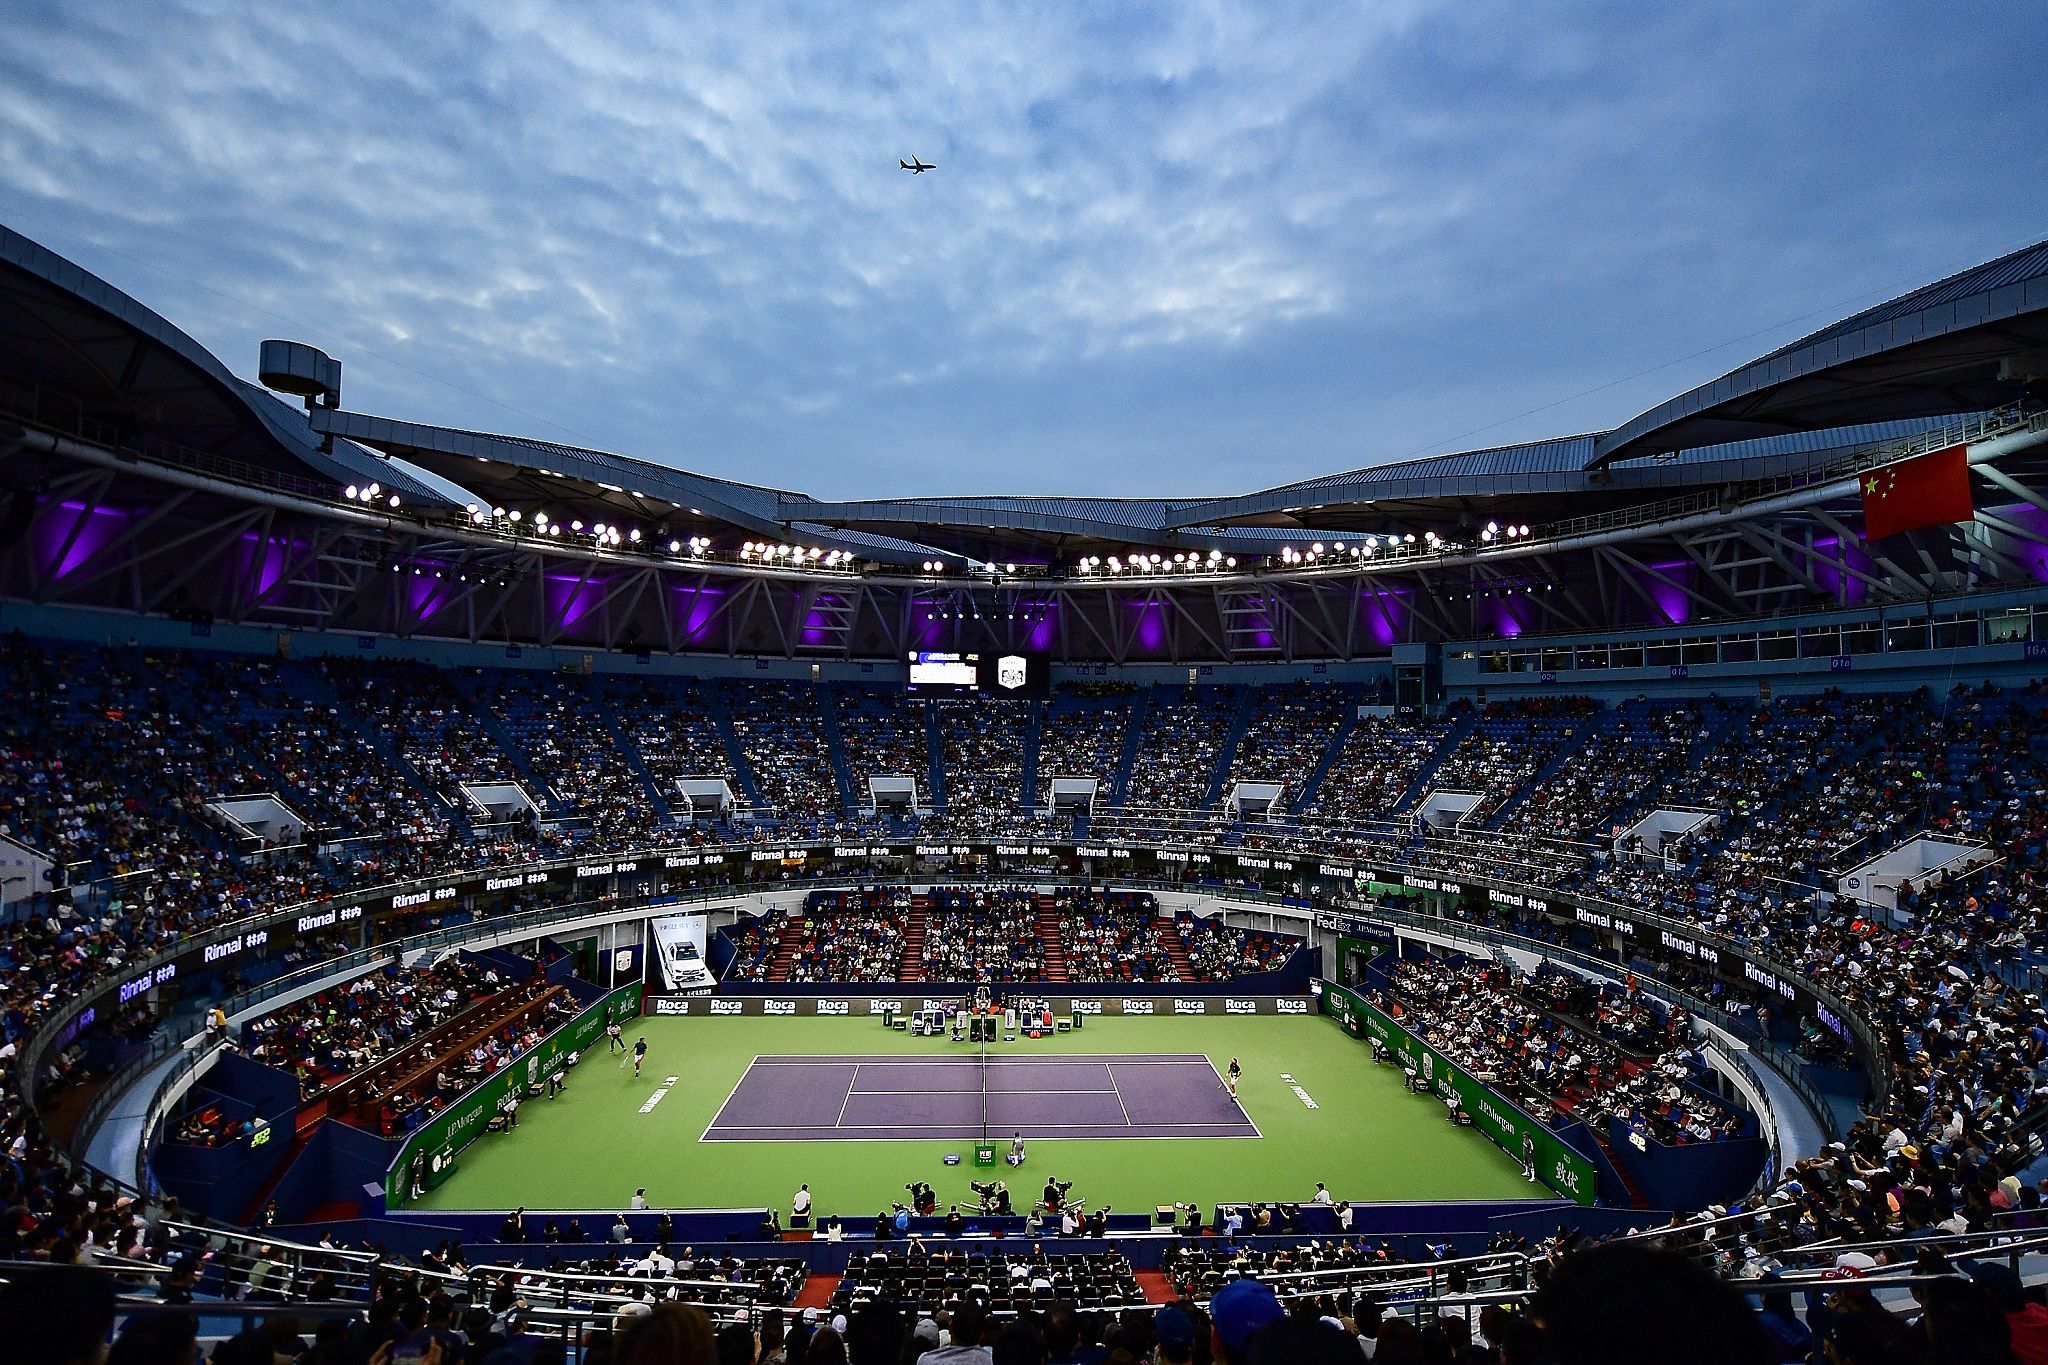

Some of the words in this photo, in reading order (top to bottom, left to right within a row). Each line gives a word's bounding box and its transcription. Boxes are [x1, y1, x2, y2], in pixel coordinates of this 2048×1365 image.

[2026, 644, 2047, 656] 16A
[1832, 659, 1850, 668] 01B
[1671, 668, 1686, 676] 01A
[752, 850, 785, 862] Rinnai
[835, 845, 866, 856] Rinnai
[916, 846, 947, 854] Rinnai
[997, 846, 1027, 854] Rinnai
[1077, 845, 1108, 857] Rinnai
[1157, 849, 1188, 861] Rinnai
[666, 854, 699, 867] Rinnai
[1238, 855, 1269, 868] Rinnai
[575, 862, 612, 877] Rinnai
[1320, 863, 1354, 877] Rinnai
[487, 871, 522, 887] Rinnai
[1404, 874, 1436, 891] Rinnai
[393, 890, 430, 908] Rinnai
[1490, 890, 1522, 907] Rinnai
[298, 910, 335, 932] Rinnai
[1316, 915, 1351, 933] FedEx
[1577, 908, 1610, 927] Rinnai
[205, 936, 242, 962] Rinnai
[1662, 931, 1695, 954] Rinnai
[1746, 962, 1775, 990] Rinnai
[120, 971, 152, 1002] Rinnai
[657, 999, 689, 1010] Roca
[710, 999, 742, 1010] Roca
[764, 999, 795, 1010] Roca
[817, 999, 848, 1010] Roca
[870, 999, 902, 1010] Roca
[1071, 999, 1101, 1010] Roca
[1123, 999, 1153, 1010] Roca
[1174, 999, 1205, 1009] Roca
[1225, 999, 1256, 1009] Roca
[1276, 998, 1307, 1009] Roca
[1817, 1001, 1840, 1036] Rinnai
[542, 1050, 564, 1074] ROLEX
[1397, 1047, 1418, 1070] ROLEX
[497, 1083, 522, 1110] ROLEX
[1438, 1078, 1463, 1106] ROLEX
[1555, 1161, 1579, 1194] 致优
